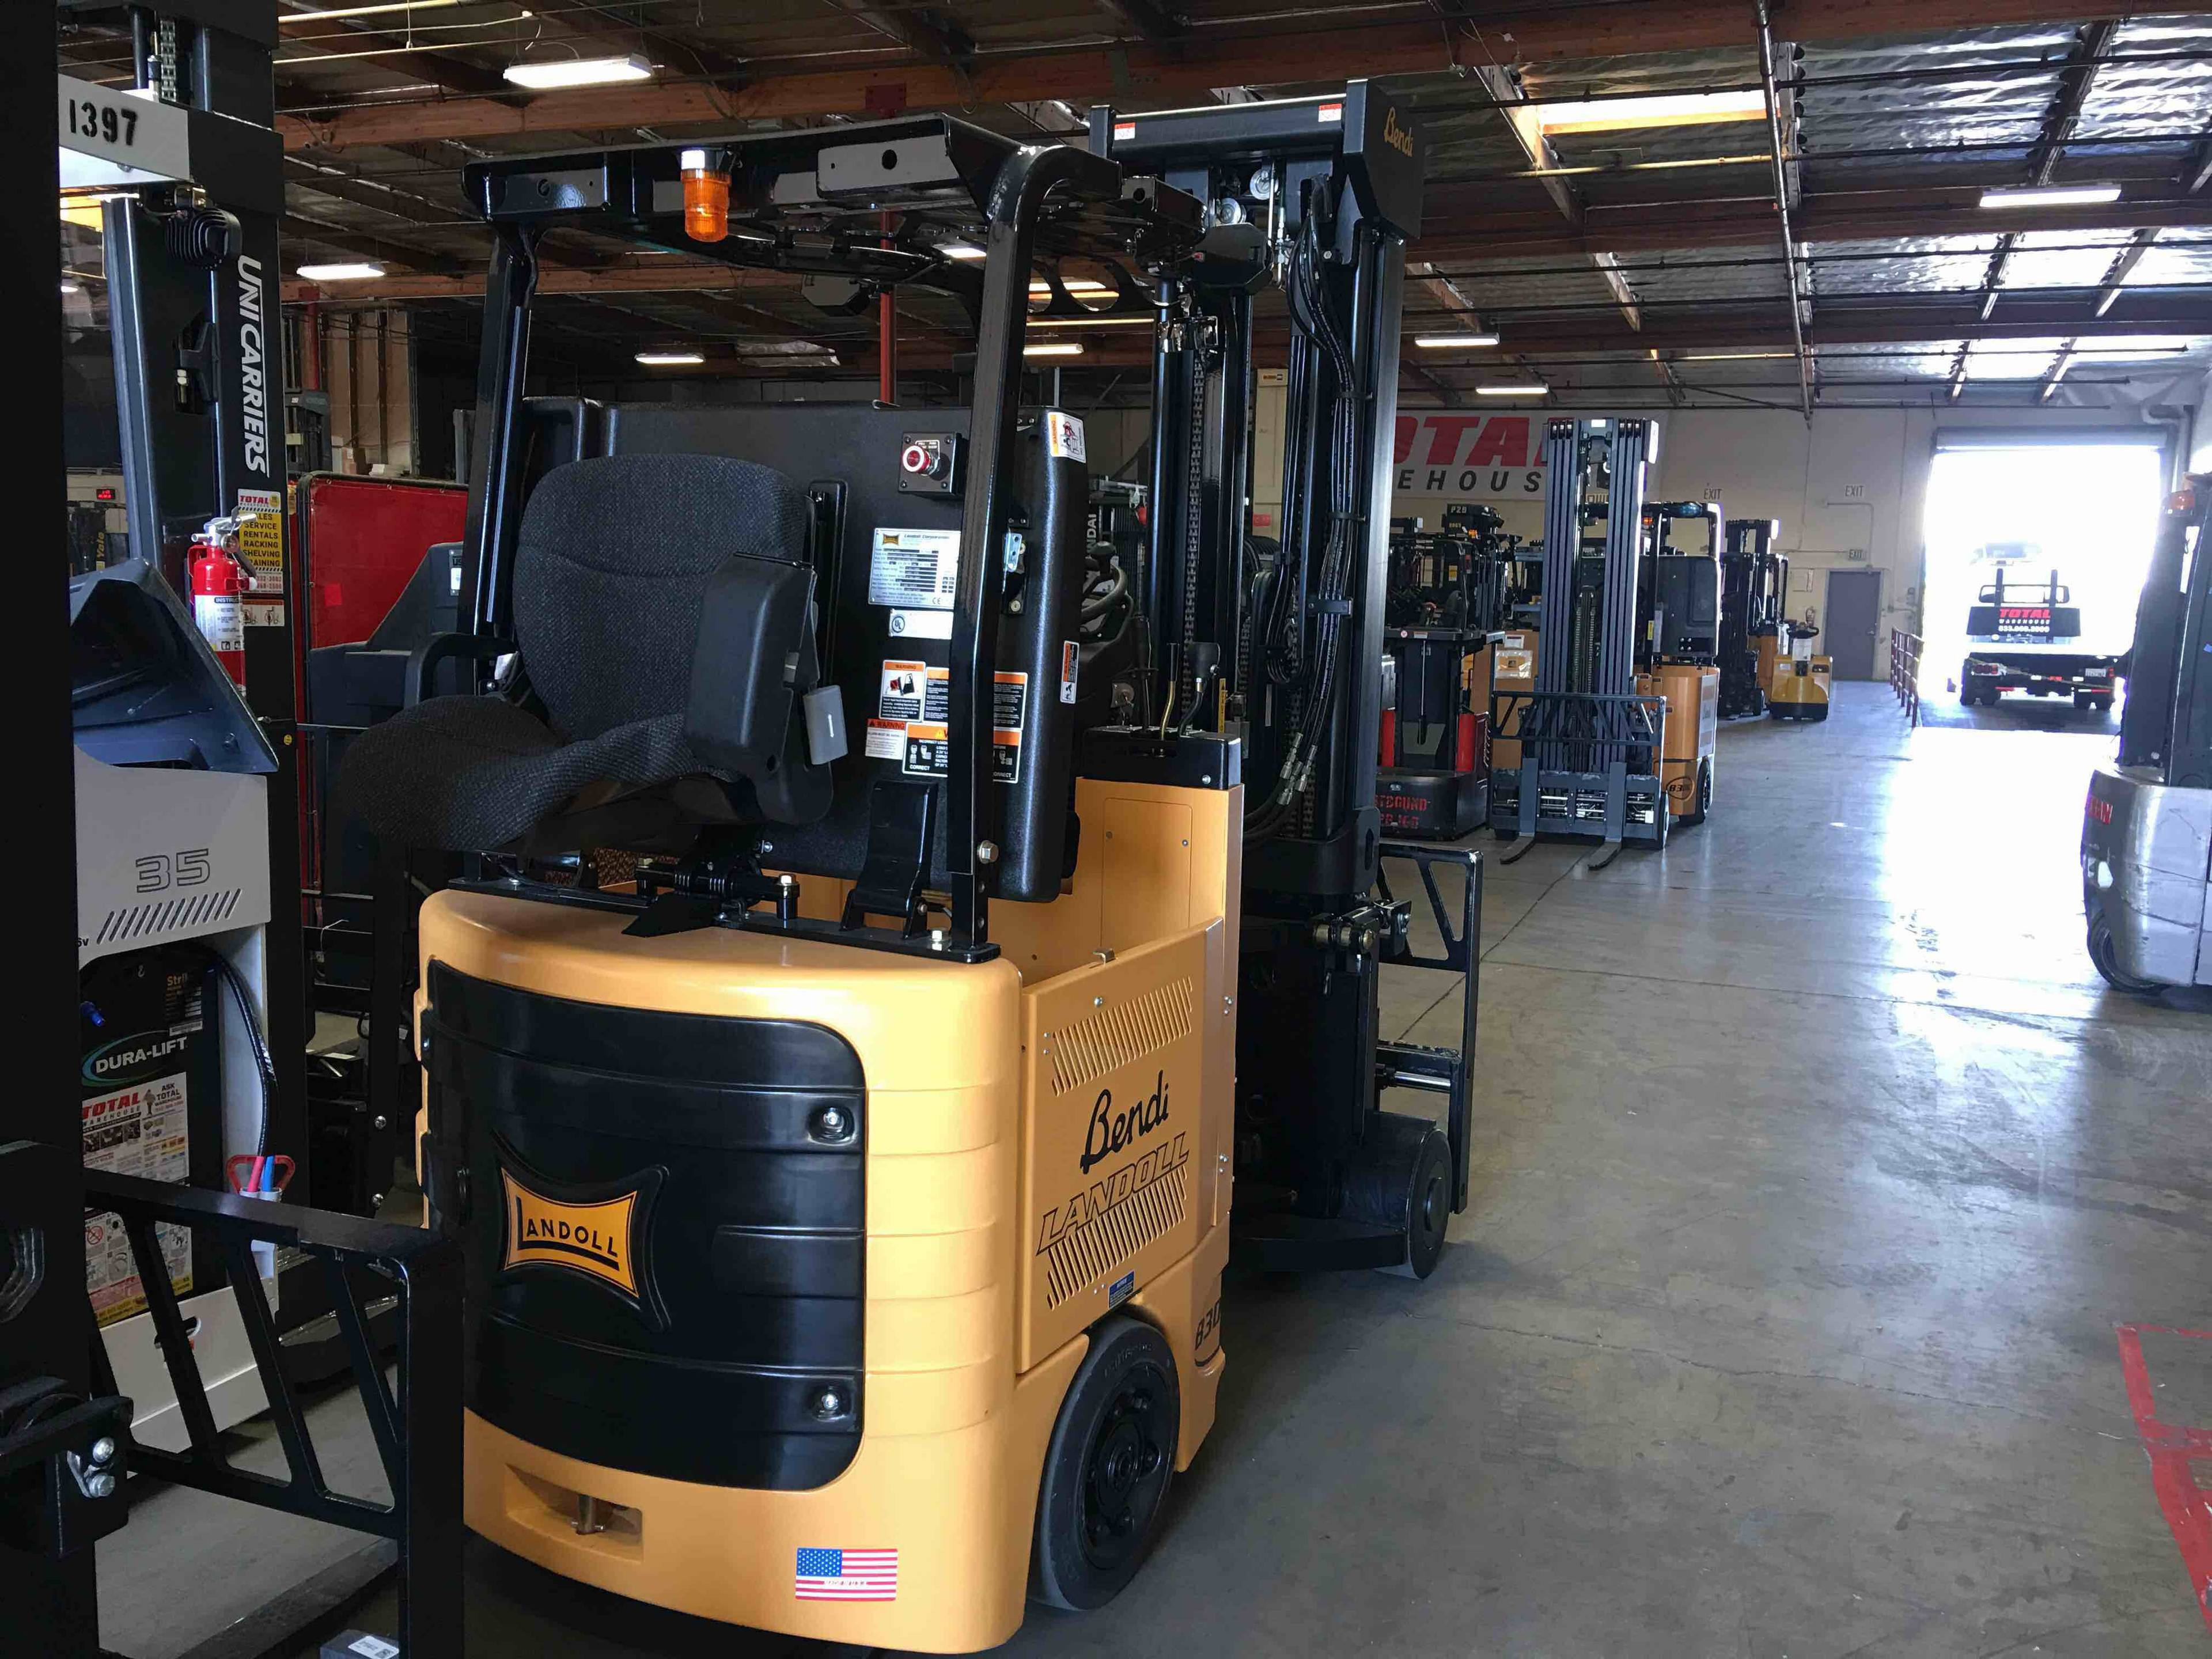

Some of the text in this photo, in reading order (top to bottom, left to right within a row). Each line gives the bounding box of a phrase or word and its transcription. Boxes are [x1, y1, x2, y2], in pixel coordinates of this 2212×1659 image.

[69, 98, 139, 147] 1397
[1384, 107, 1413, 158] Bendi
[236, 254, 270, 478] UNICARRIERS
[1397, 469, 1542, 492] EHOUS
[1703, 488, 1722, 500] EXIT
[1845, 486, 1864, 497] EXIT
[240, 495, 268, 505] TOTAL
[245, 521, 277, 530] SERVICE
[244, 531, 278, 539] RENTALS
[97, 532, 105, 559] Yale
[244, 540, 278, 548] RACKING
[243, 550, 281, 558] SHELVING
[1850, 549, 1862, 558] EXIT
[1999, 608, 2051, 618] TOTAL
[877, 721, 905, 729] WARNING
[135, 849, 210, 893] 35
[96, 1036, 187, 1074] DURA-LIFT
[161, 1082, 175, 1092] ASK
[157, 1089, 180, 1101] TOTAL
[82, 1092, 141, 1119] TOTAL
[1080, 1069, 1169, 1175] Bendi
[1036, 1131, 1190, 1256] LANDOLL
[516, 1196, 620, 1271] LANDOLL
